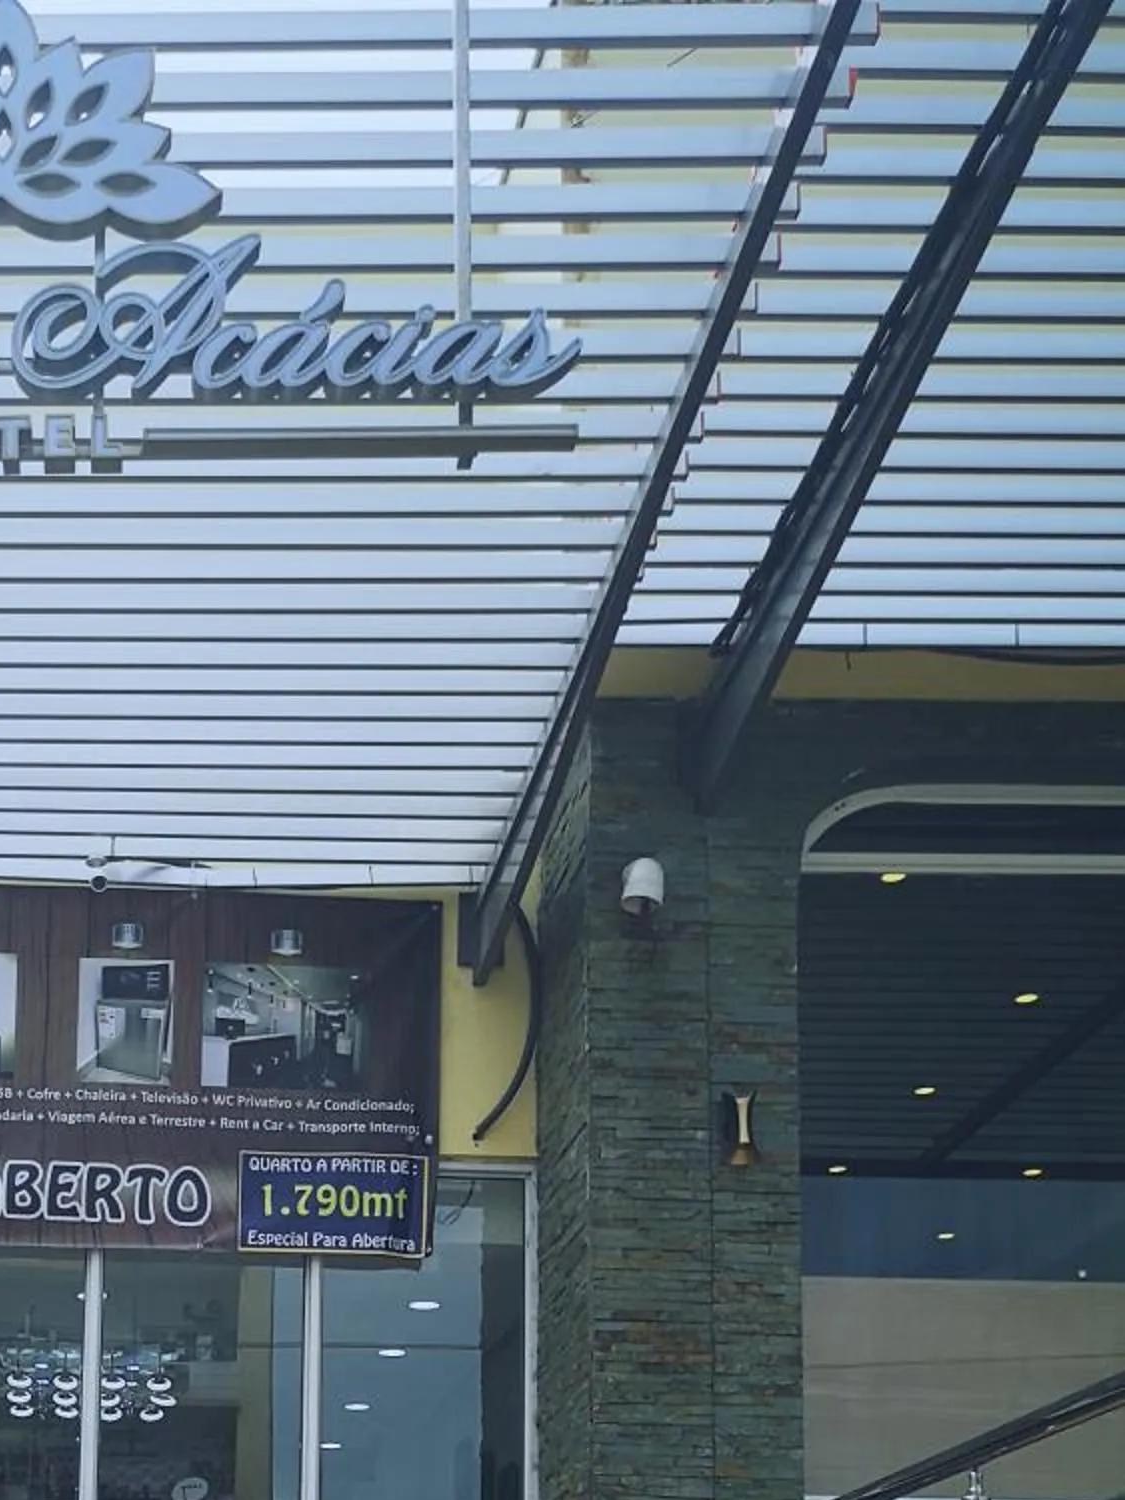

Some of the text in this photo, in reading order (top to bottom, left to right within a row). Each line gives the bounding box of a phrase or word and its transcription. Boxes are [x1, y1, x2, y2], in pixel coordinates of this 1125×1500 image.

[12, 233, 583, 400] Acácias
[27, 1088, 62, 1100] Cofre
[76, 1088, 126, 1101] Chaleira
[141, 1091, 198, 1104] Televisão
[213, 1094, 235, 1106] WC
[237, 1096, 292, 1109] Privativo
[306, 1099, 321, 1110] Ar
[324, 1099, 416, 1114] Condicionado;
[47, 1111, 95, 1125] Viagem
[98, 1112, 136, 1125] Aérea
[138, 1115, 146, 1125] e
[149, 1113, 206, 1127] Terrestre
[220, 1117, 249, 1129] Rent
[252, 1121, 259, 1130] a
[262, 1119, 283, 1131] Car
[298, 1121, 366, 1135] Transporte
[248, 1156, 312, 1173] QUARTO
[316, 1158, 328, 1173] A
[331, 1158, 386, 1174] PARTIR
[248, 1229, 416, 1251] Especial Para Abertura
